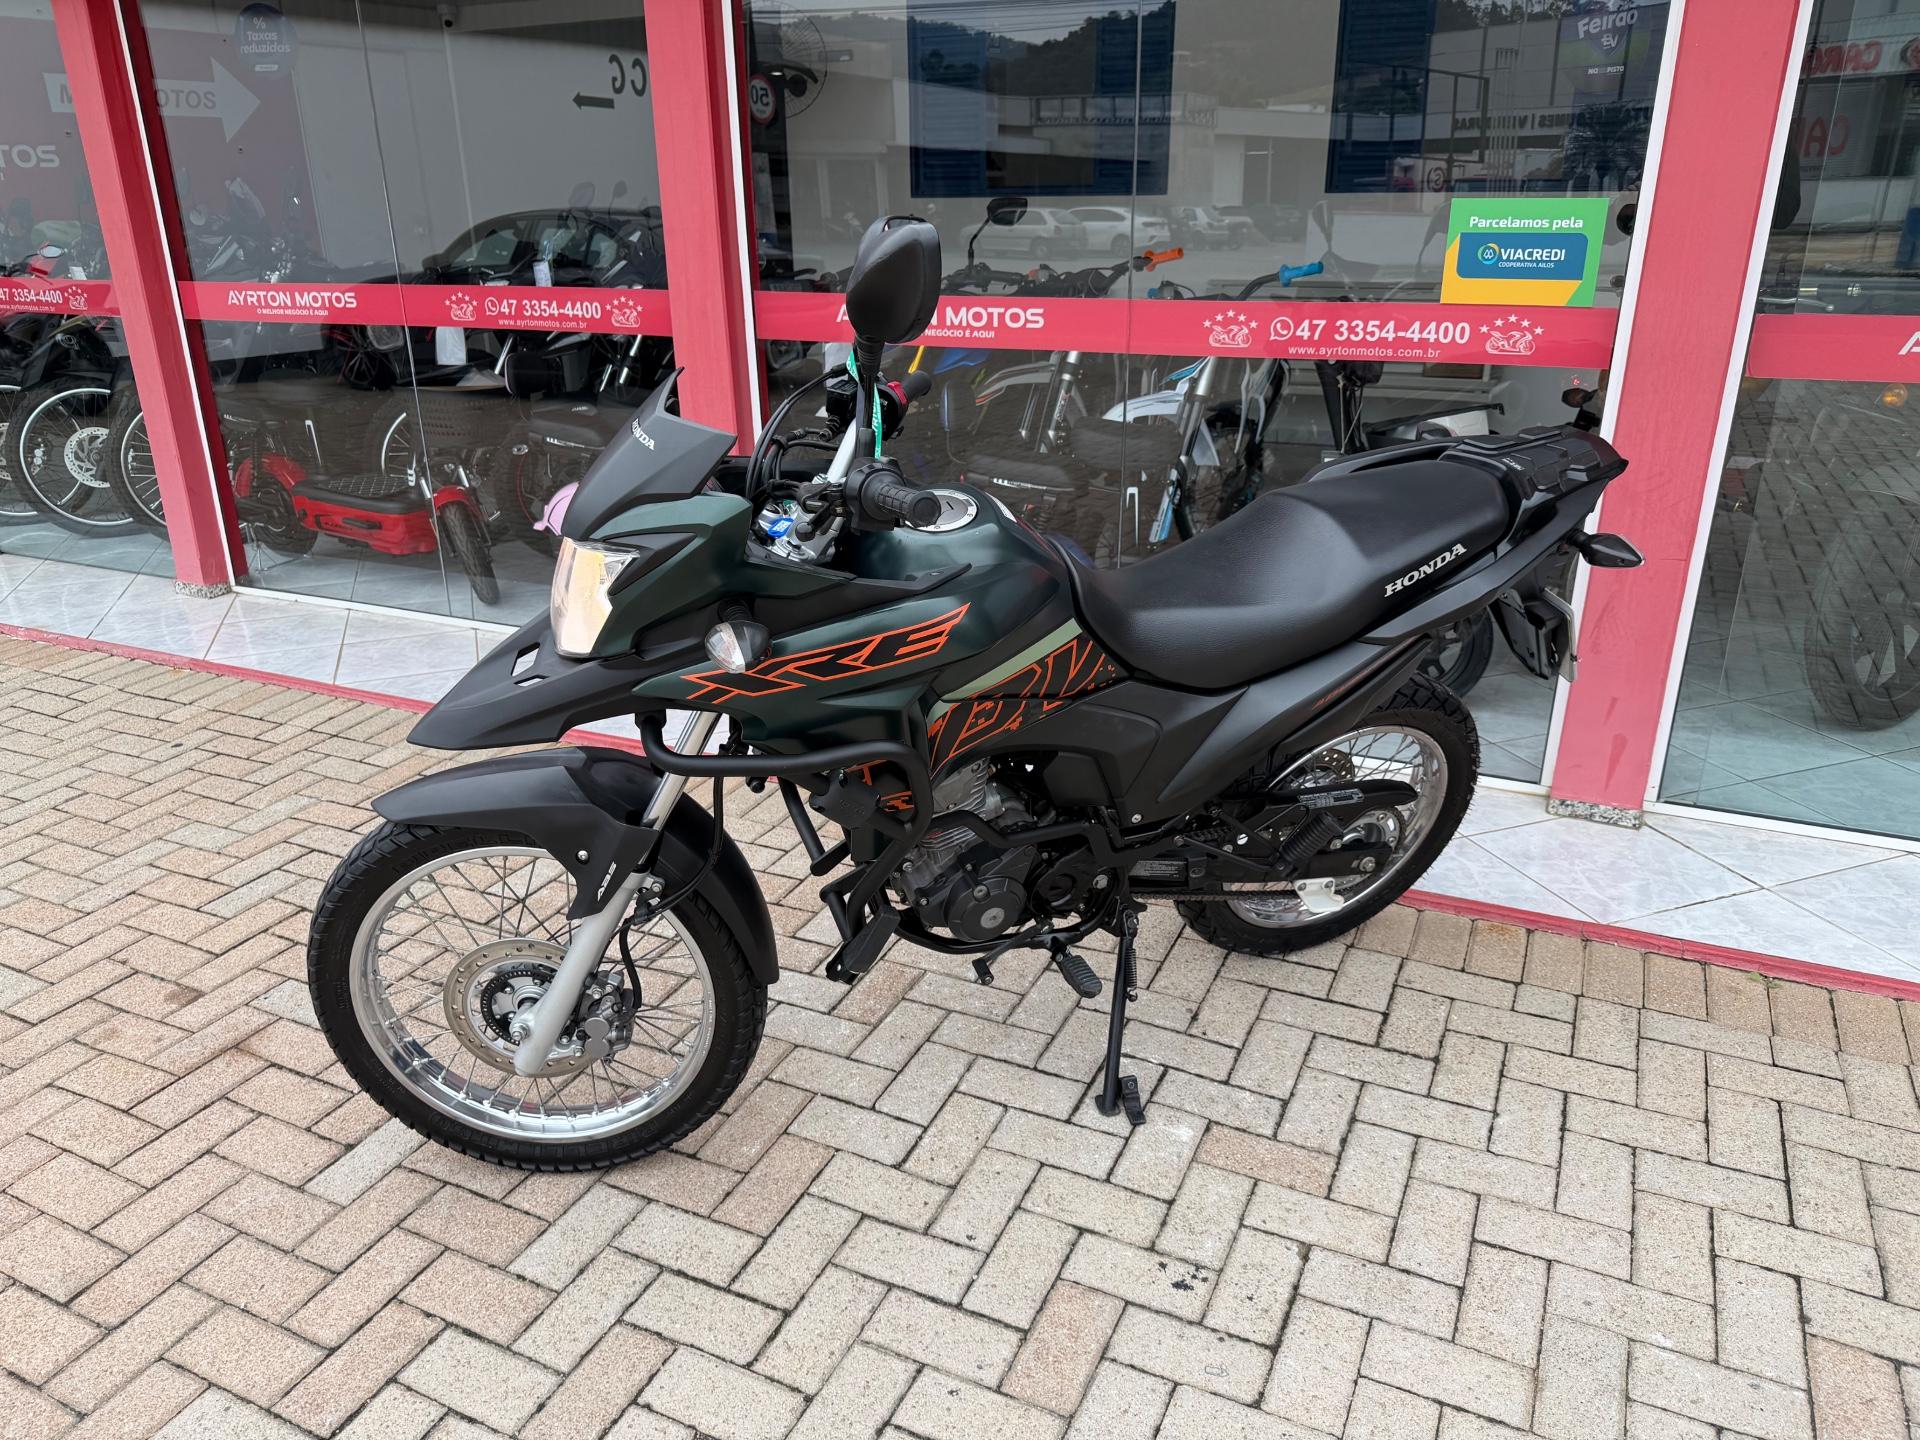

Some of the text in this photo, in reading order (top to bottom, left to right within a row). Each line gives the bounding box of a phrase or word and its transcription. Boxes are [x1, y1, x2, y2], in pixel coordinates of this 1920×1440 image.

[247, 31, 278, 41] Taxas
[240, 41, 291, 54] reduzidas
[1469, 216, 1584, 231] Parcelamos pela
[1500, 248, 1566, 261] VIACREDI
[12, 288, 63, 304] 3354-4400
[228, 290, 357, 309] AYRTON MOTOS
[501, 299, 602, 319] 47 3354-4400
[498, 317, 588, 329] www.ayrtonmotos.com.br
[946, 306, 1045, 329] MOTOS
[925, 327, 995, 338] NEGÓCIO É AQUI
[1295, 319, 1471, 344] 47 3354-4400
[1288, 344, 1441, 359] www.ayrtonmotos.com.br
[631, 417, 655, 451] HONDA
[1384, 543, 1468, 598] HONDA
